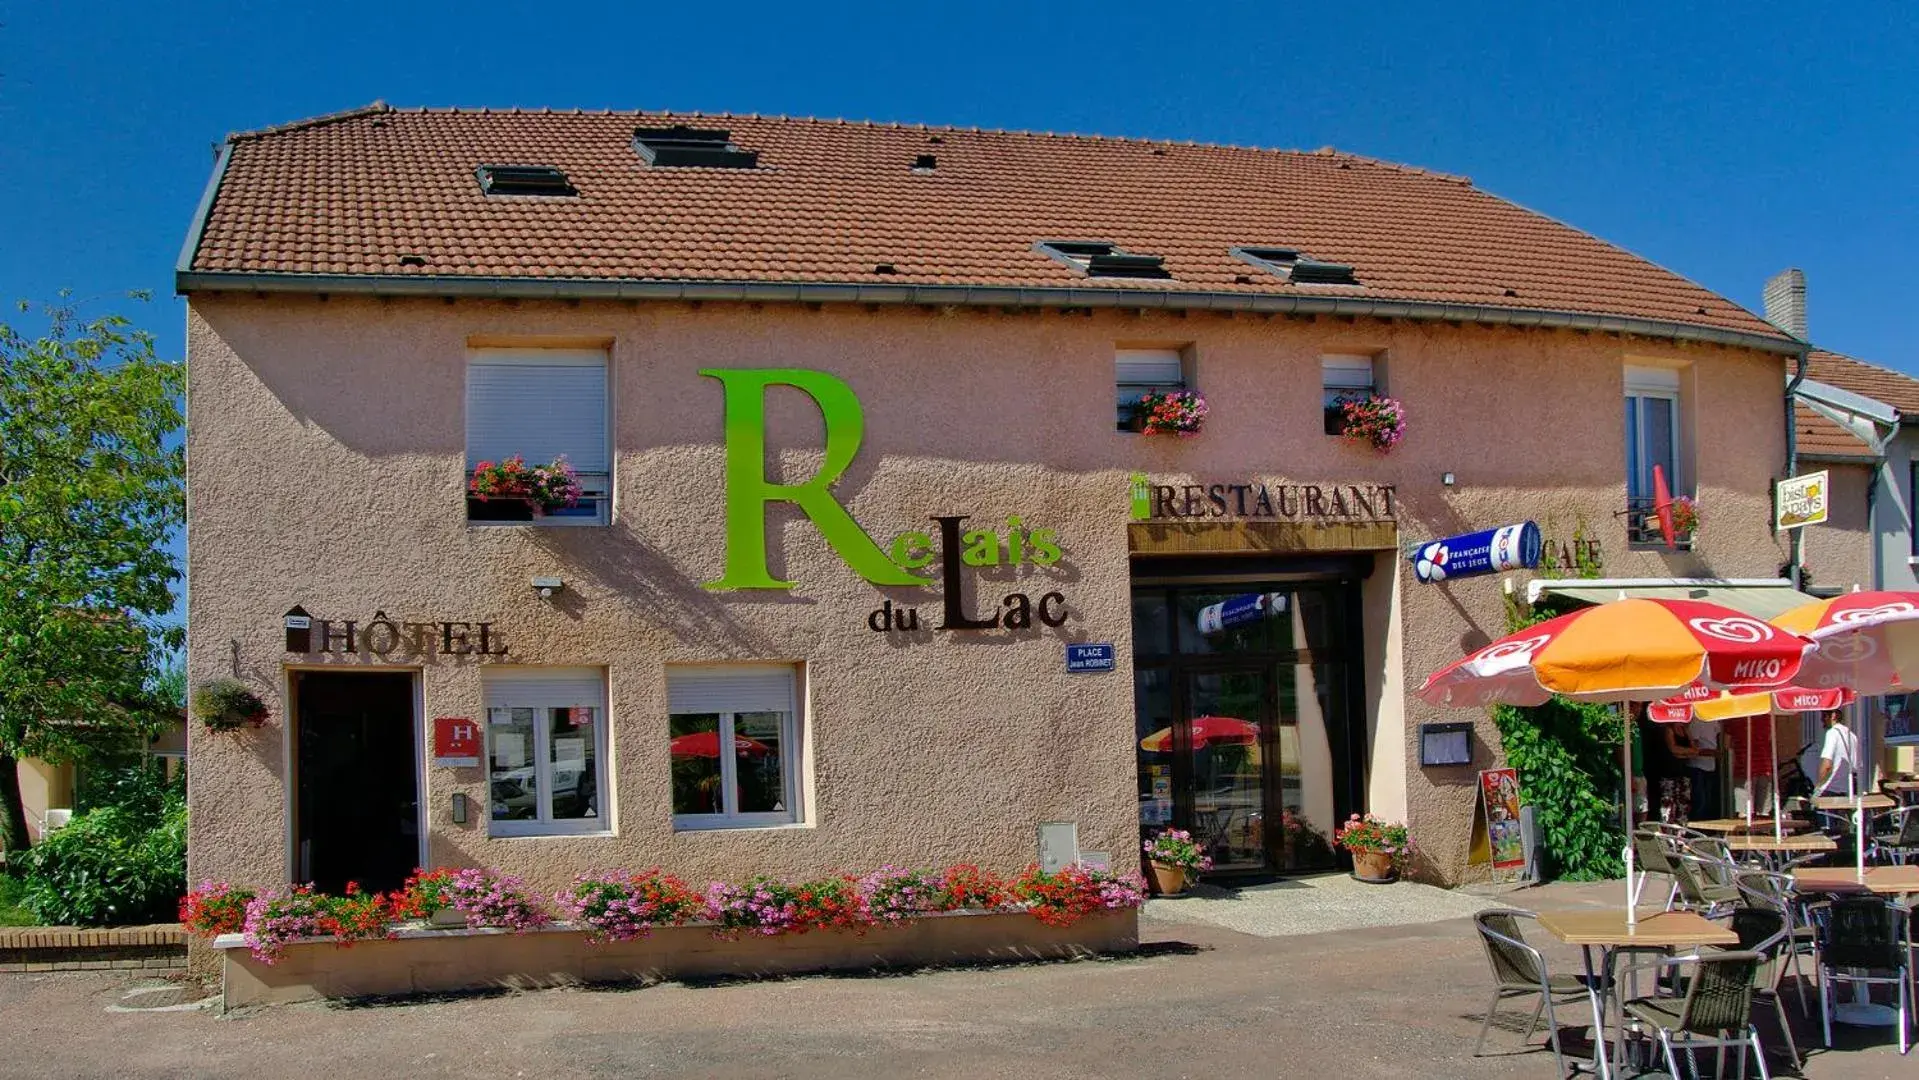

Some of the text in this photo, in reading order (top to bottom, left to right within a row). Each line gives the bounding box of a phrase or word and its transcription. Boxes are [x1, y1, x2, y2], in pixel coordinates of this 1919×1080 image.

[1155, 484, 1397, 518] RESTAURANT
[1449, 546, 1490, 560] FRANÇAISE
[1452, 558, 1488, 570] DES JEUX
[868, 515, 1068, 632] du Lac
[317, 610, 509, 656] HÔTEL
[1077, 648, 1103, 657] PLACE
[1086, 658, 1111, 668] ROBINET
[1734, 659, 1780, 678] MIKO
[1684, 686, 1709, 699] MIKO
[1794, 695, 1819, 706] MIKO
[454, 725, 472, 740] H
